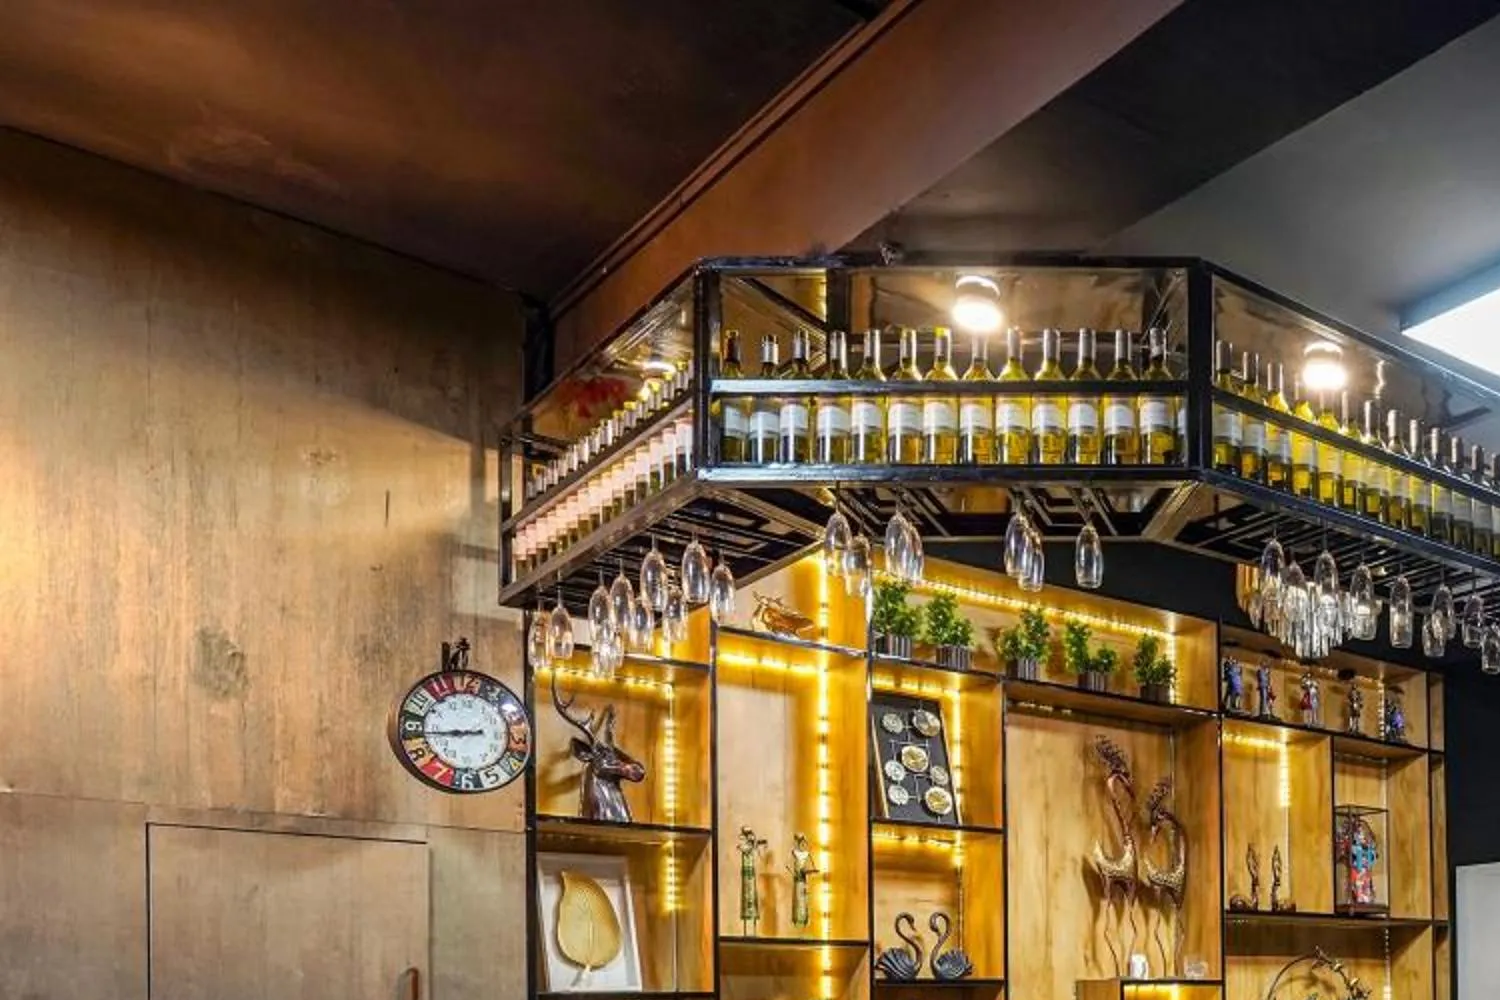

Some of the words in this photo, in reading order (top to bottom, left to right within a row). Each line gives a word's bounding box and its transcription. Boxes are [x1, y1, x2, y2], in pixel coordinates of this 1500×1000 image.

[410, 692, 429, 710] 10
[405, 721, 423, 731] 9
[409, 747, 425, 760] 8
[461, 773, 474, 789] 6
[484, 768, 500, 784] 5
